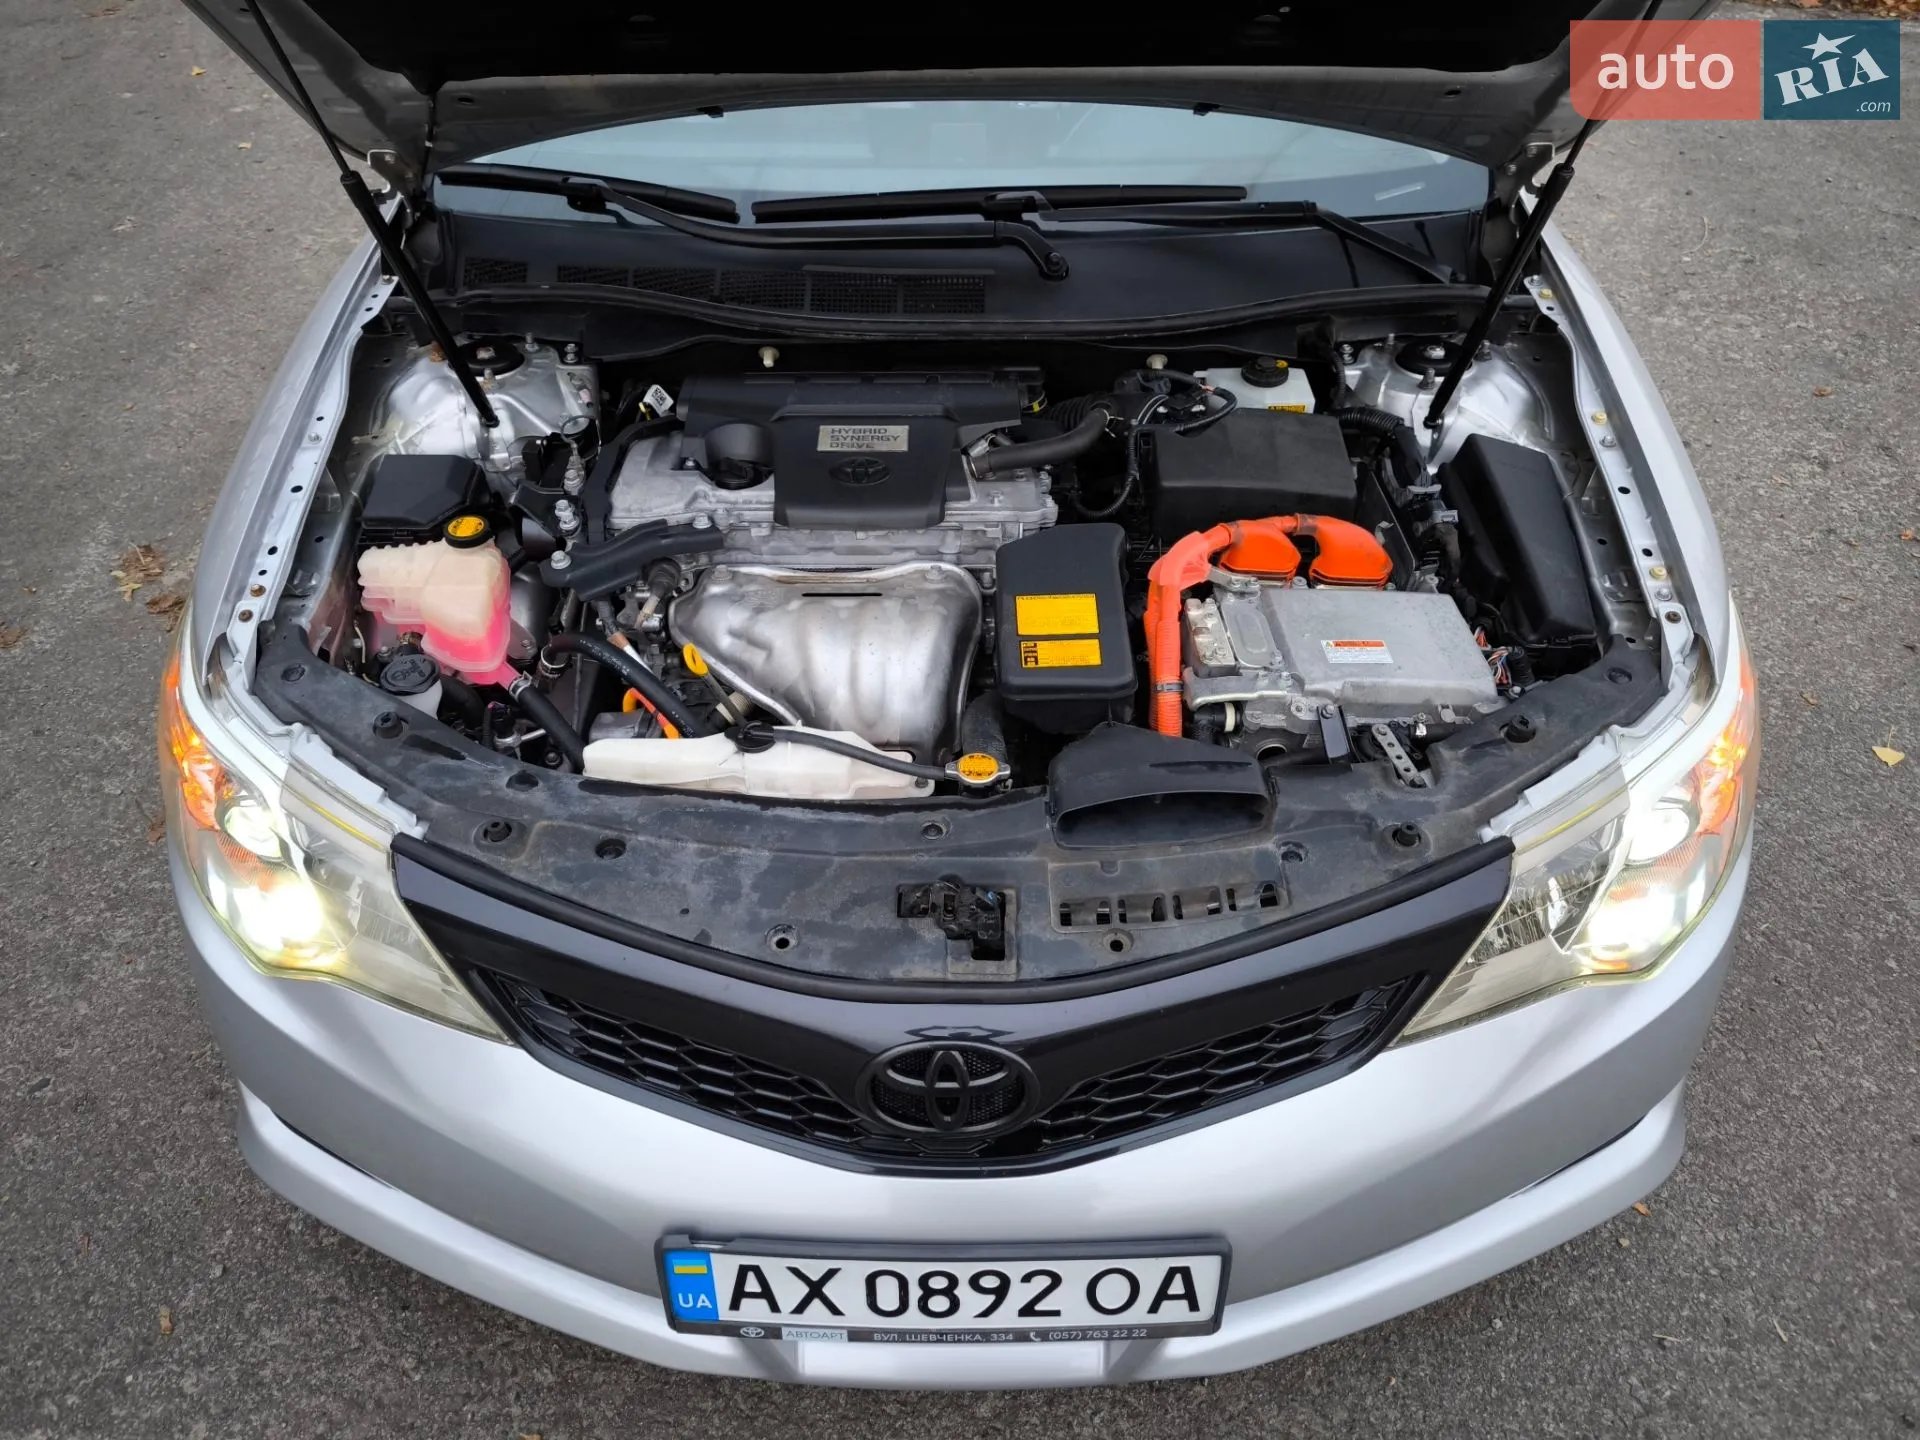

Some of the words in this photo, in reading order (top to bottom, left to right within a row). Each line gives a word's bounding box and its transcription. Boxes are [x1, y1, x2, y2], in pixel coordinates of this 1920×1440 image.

[830, 427, 888, 435] HYBRID
[830, 434, 900, 442] SYNERGY
[829, 441, 875, 449] DRIVE
[728, 1263, 845, 1317] AX
[865, 1268, 1063, 1319] 0892
[1085, 1265, 1201, 1316] OA
[678, 1292, 714, 1309] UA
[990, 1333, 1014, 1341] 334
[1048, 1331, 1082, 1341] (057)
[1086, 1330, 1109, 1339] 763
[1113, 1329, 1129, 1338] 22
[1132, 1328, 1148, 1338] 22
